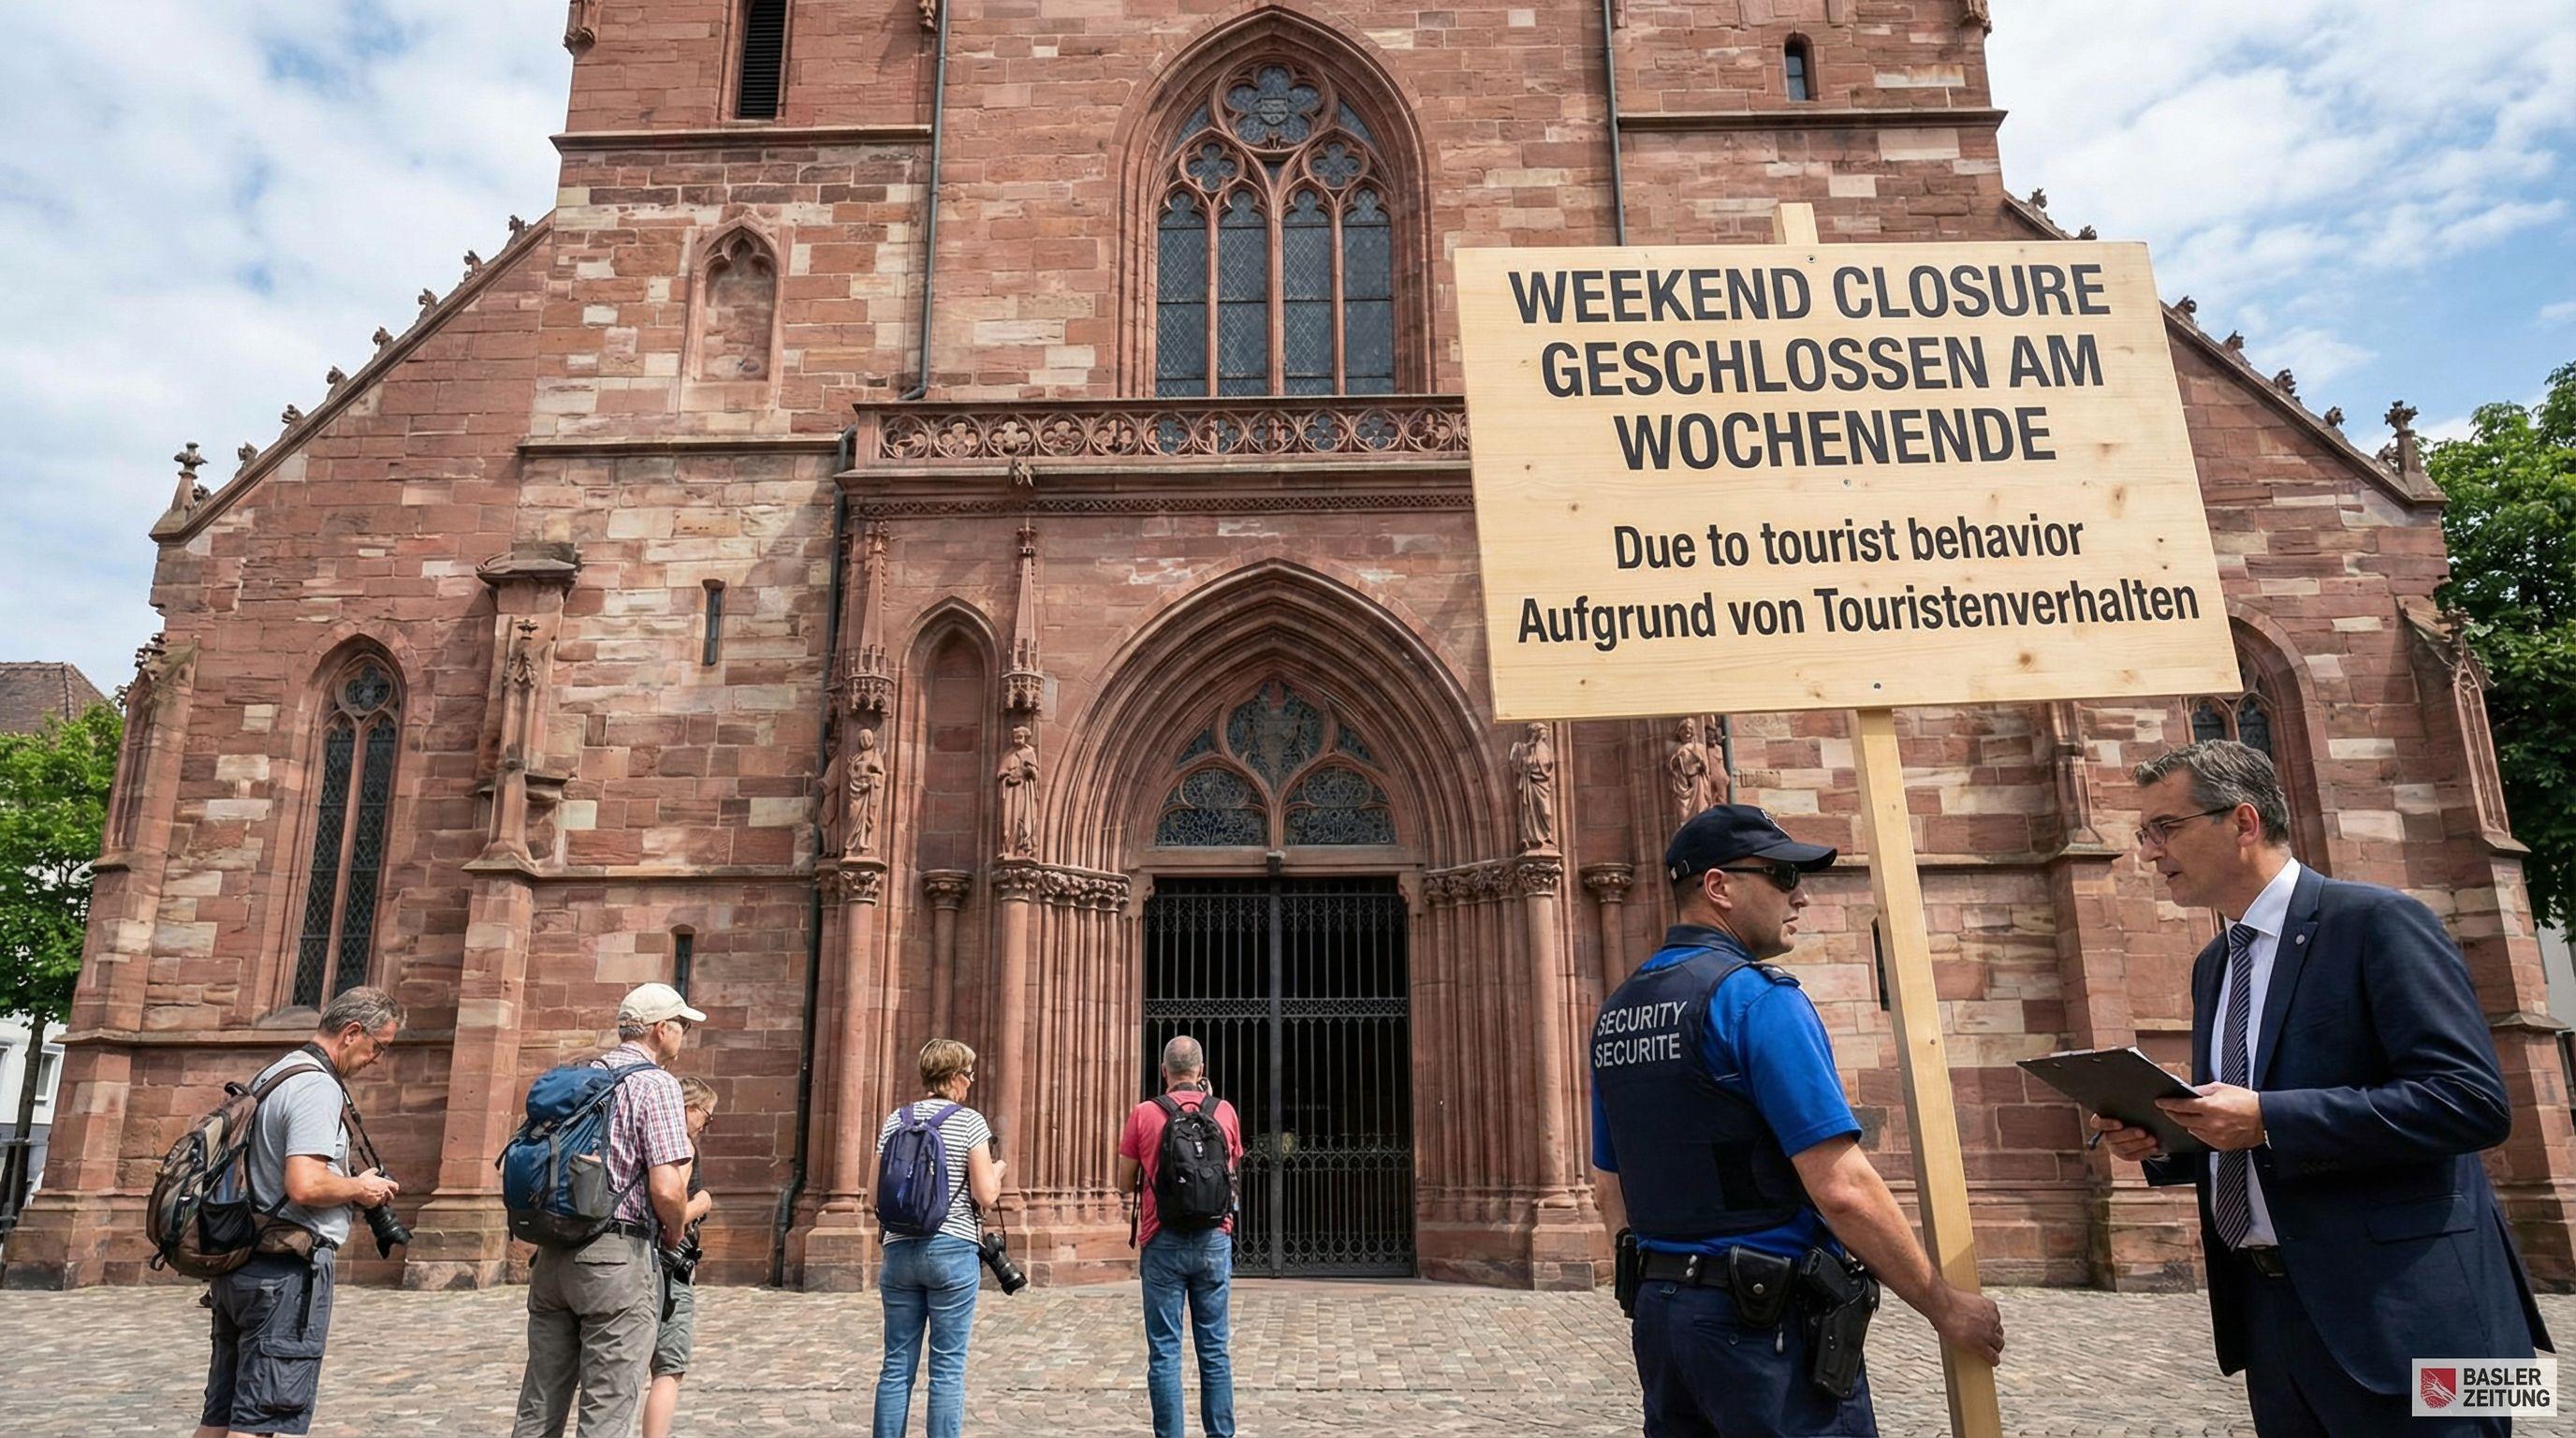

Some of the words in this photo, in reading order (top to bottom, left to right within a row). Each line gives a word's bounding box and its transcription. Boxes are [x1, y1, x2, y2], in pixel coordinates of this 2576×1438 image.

[1509, 269, 1811, 323] WEEKEND
[1834, 264, 2111, 318] CLOSURE
[1543, 336, 1990, 398] GESCHLOSSEN
[2009, 334, 2104, 388] AM
[1614, 406, 2056, 470] WOCHENENDE
[1615, 526, 1696, 569] Due
[1707, 525, 1749, 566] to
[1761, 519, 1899, 565] tourist
[1909, 513, 2084, 561] behavior
[1517, 593, 1717, 652] Aufgrund
[1728, 599, 1805, 636] von
[1813, 578, 2200, 633] Touristenverhalten
[1597, 1001, 1688, 1036] SECURITY
[1594, 1033, 1681, 1069] SECURITE
